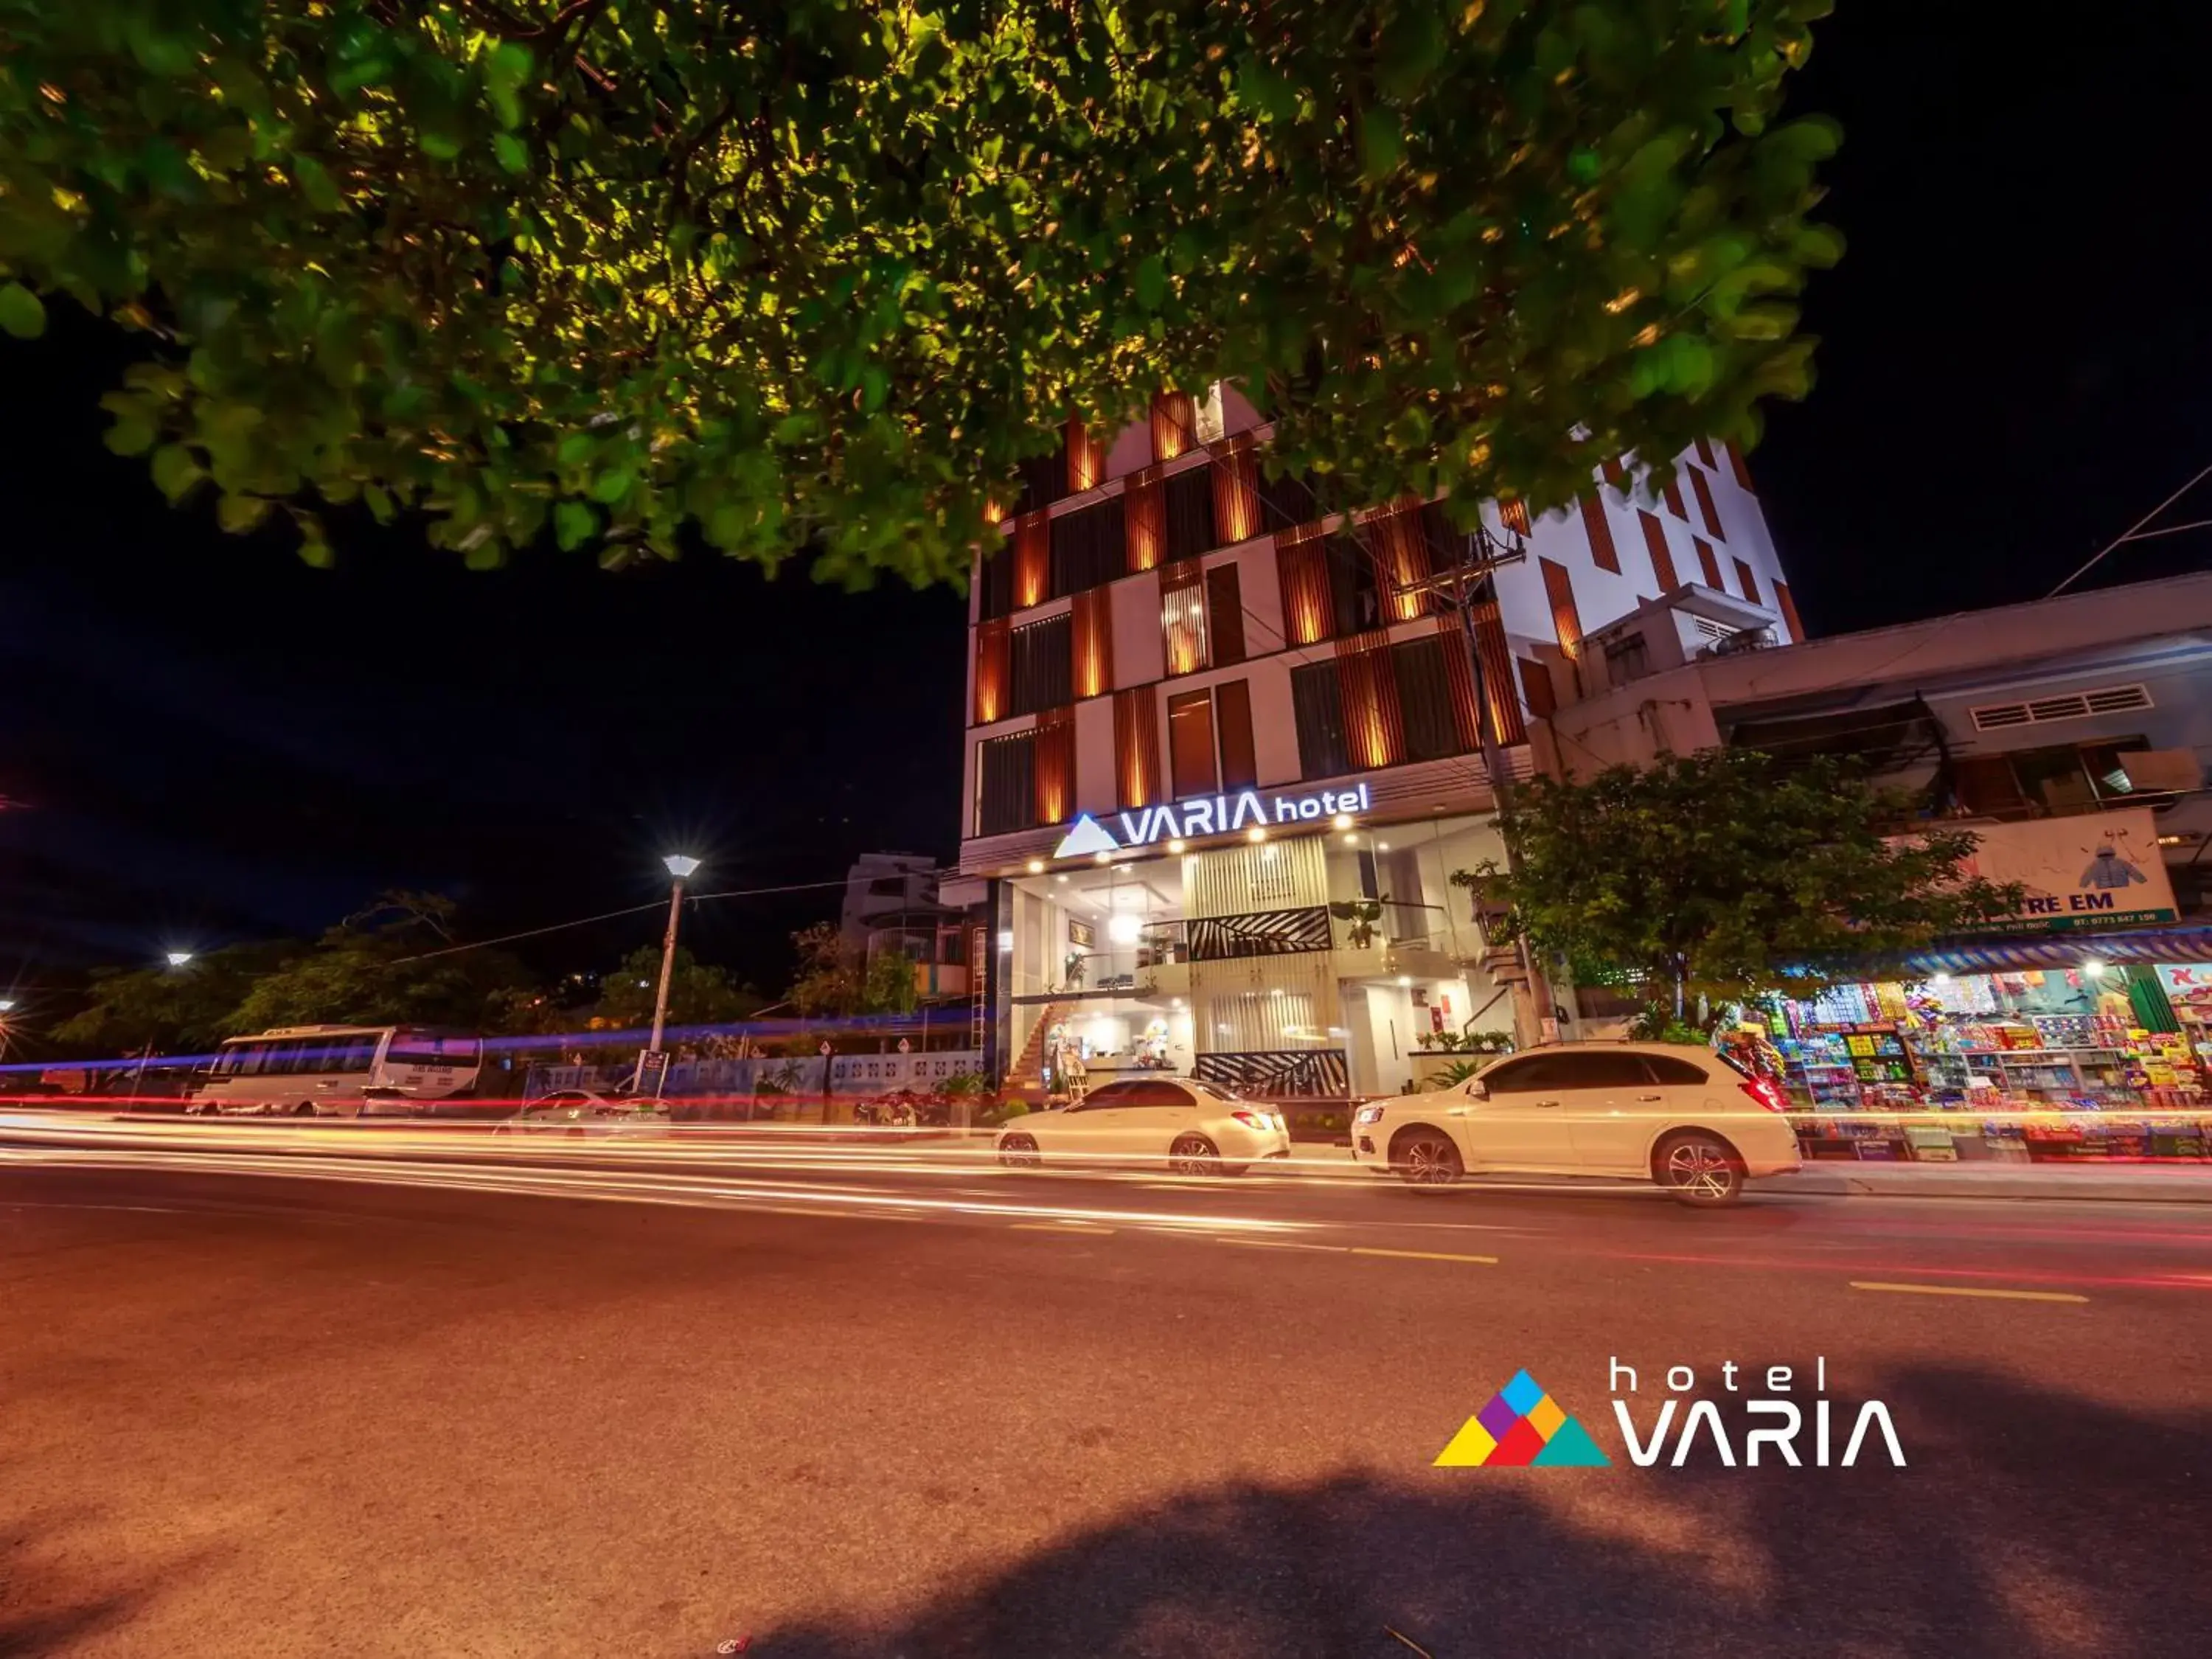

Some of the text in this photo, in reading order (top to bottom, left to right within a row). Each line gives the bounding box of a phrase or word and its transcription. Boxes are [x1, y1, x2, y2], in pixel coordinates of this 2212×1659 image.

[1121, 783, 1368, 844] VARIA hotel
[2069, 892, 2114, 911] EM
